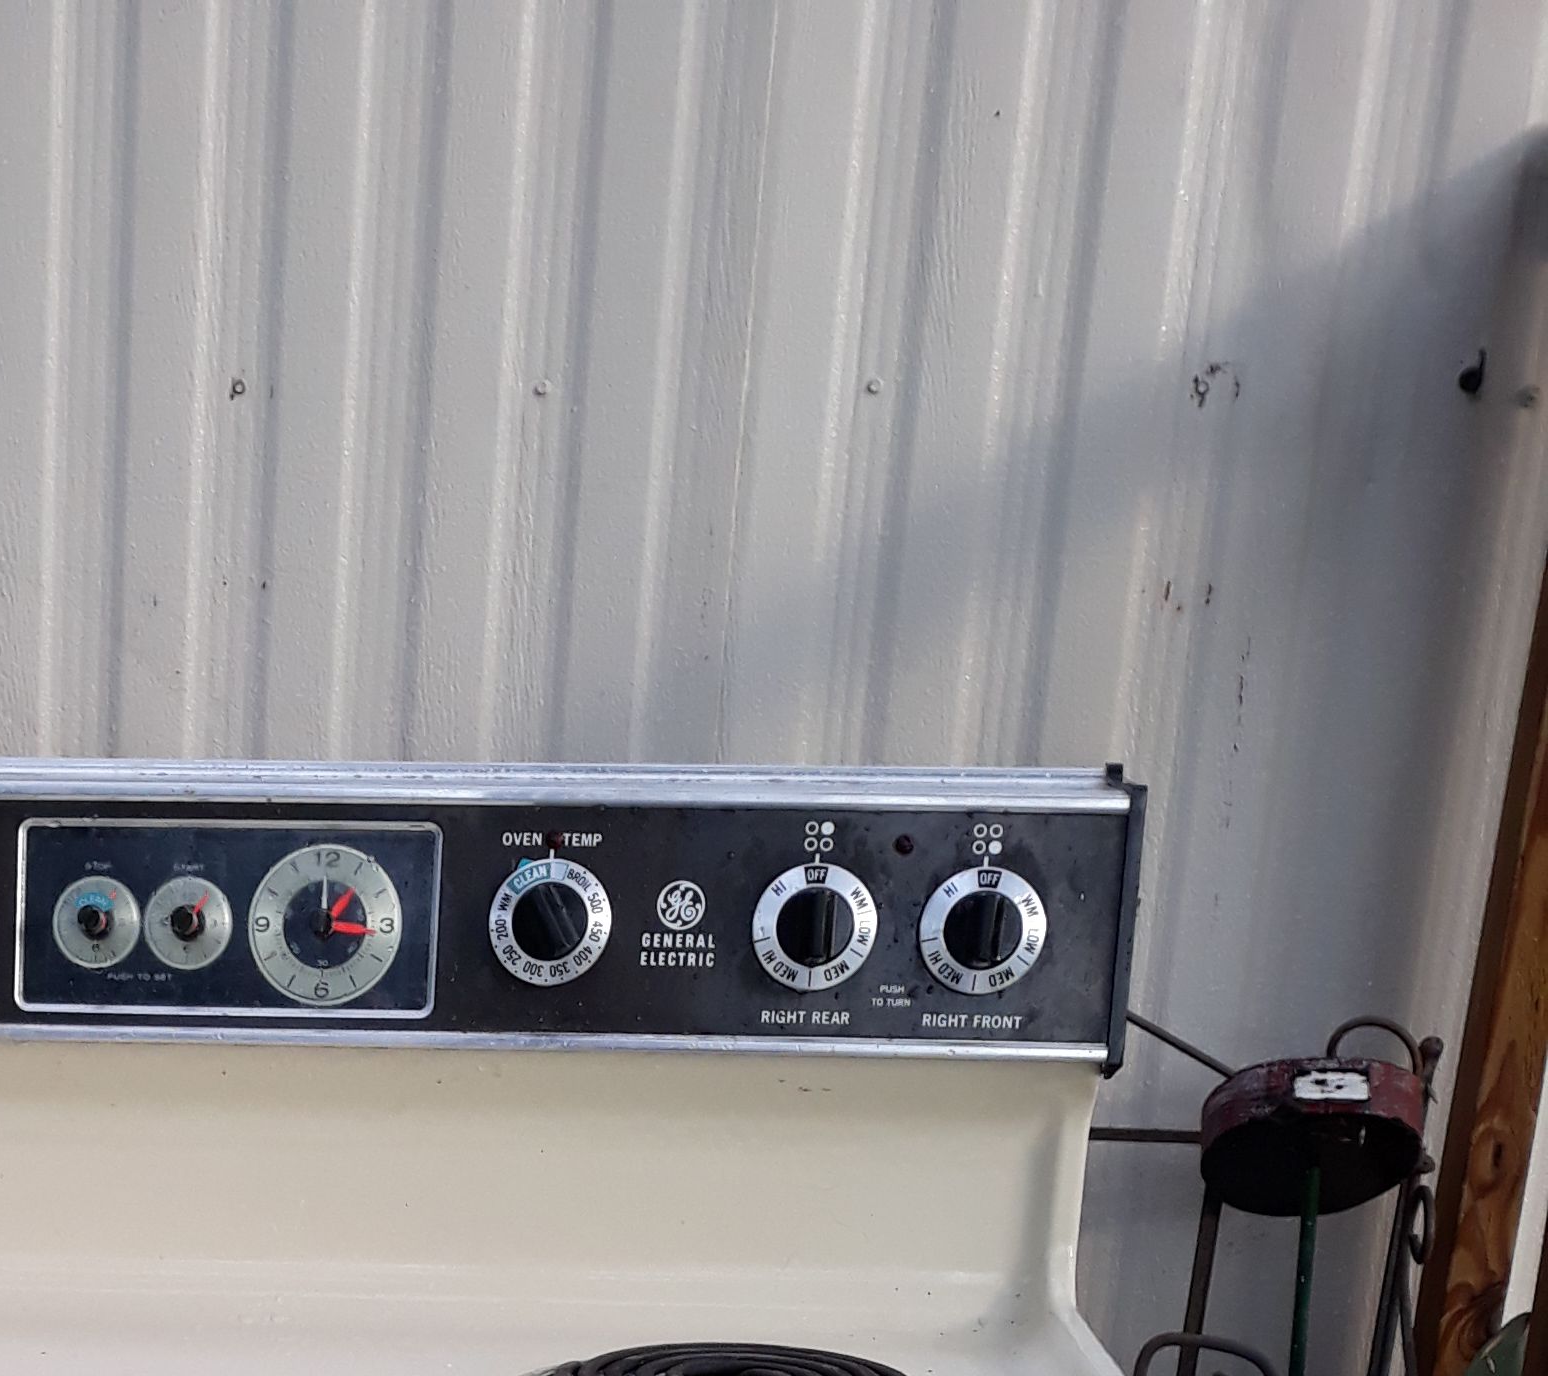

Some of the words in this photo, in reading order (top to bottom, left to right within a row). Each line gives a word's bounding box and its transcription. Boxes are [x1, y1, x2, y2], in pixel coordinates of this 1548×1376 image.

[502, 832, 543, 846] OVEN
[563, 832, 603, 847] TEMP
[315, 851, 341, 868] 12
[513, 863, 548, 888] CLEAN
[567, 868, 592, 892] BROIL
[807, 869, 826, 881] OFF
[980, 872, 1001, 885] OFF
[771, 880, 787, 896] HI
[943, 882, 959, 898] HI
[498, 893, 513, 911] WM
[588, 892, 604, 914] 500
[851, 886, 869, 910] WM
[1022, 894, 1039, 917] WM
[255, 916, 270, 932] 9
[379, 917, 394, 934] 3
[495, 919, 509, 941] 200
[589, 921, 603, 943] 450
[641, 932, 716, 949] GENERAL
[857, 920, 871, 946] LOW
[1024, 928, 1039, 953] LOW
[502, 944, 522, 966] 250
[573, 945, 593, 967] 400
[640, 951, 715, 967] ELECTRIC
[762, 950, 777, 965] HI
[928, 951, 941, 965] HI
[523, 961, 545, 978] 300
[549, 961, 571, 978] 350
[773, 961, 799, 982] MED
[824, 960, 850, 982] MED
[938, 963, 964, 984] MED
[988, 967, 1015, 988] MED
[314, 981, 329, 998] 6
[879, 985, 905, 993] PUSH
[871, 998, 884, 1006] TO
[886, 998, 912, 1007] TURN
[760, 1010, 806, 1024] RIGHT
[811, 1011, 850, 1025] REAR
[922, 1013, 969, 1028] RIGHT
[972, 1015, 1022, 1029] FRONT
